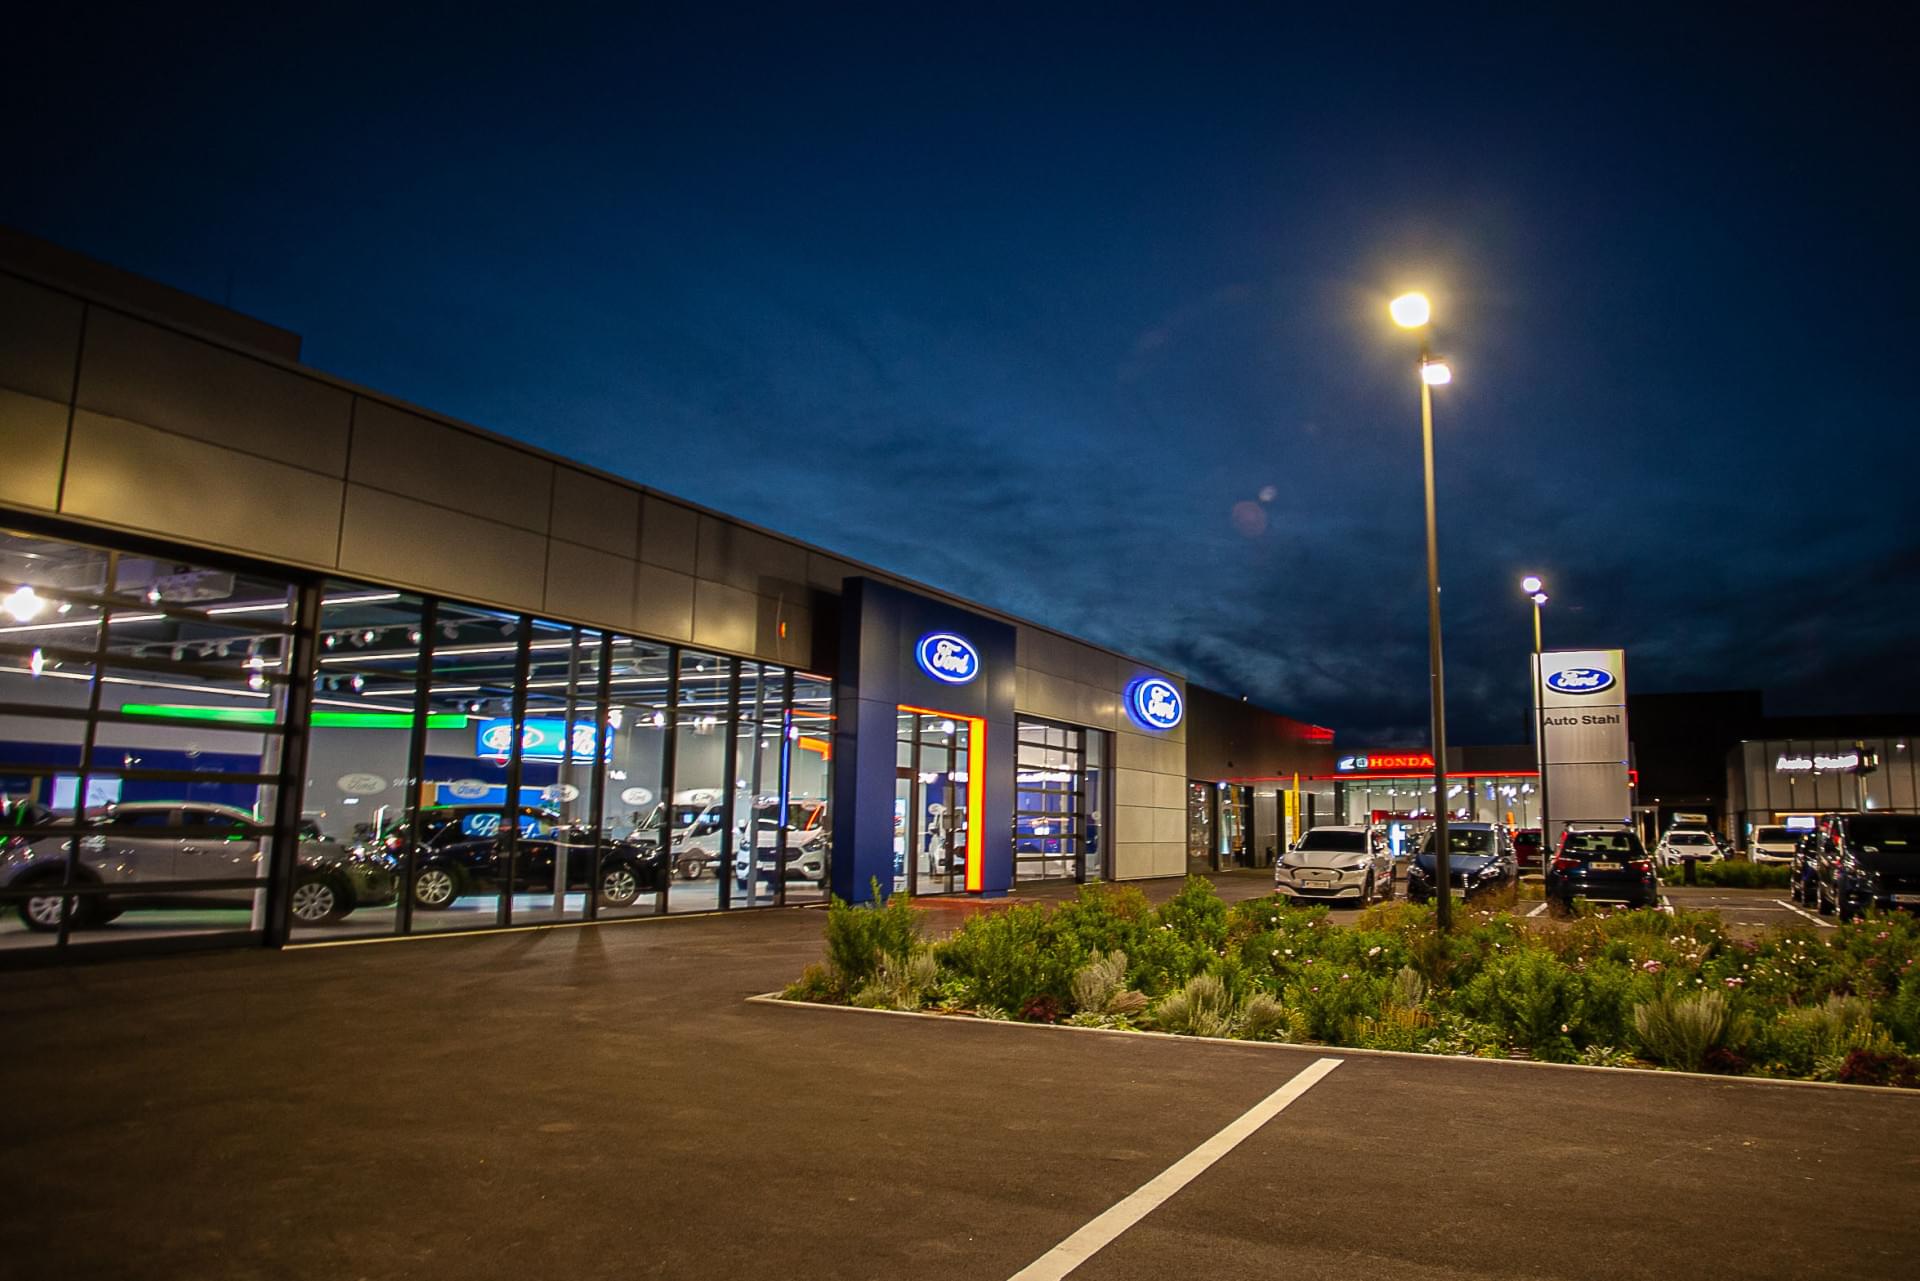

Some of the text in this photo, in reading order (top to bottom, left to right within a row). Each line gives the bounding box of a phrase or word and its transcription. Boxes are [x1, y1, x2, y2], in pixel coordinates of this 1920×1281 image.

[932, 640, 970, 674] Ford
[1557, 670, 1600, 687] Ford
[1543, 714, 1621, 727] Auto Stahl
[1369, 756, 1436, 767] HONDA
